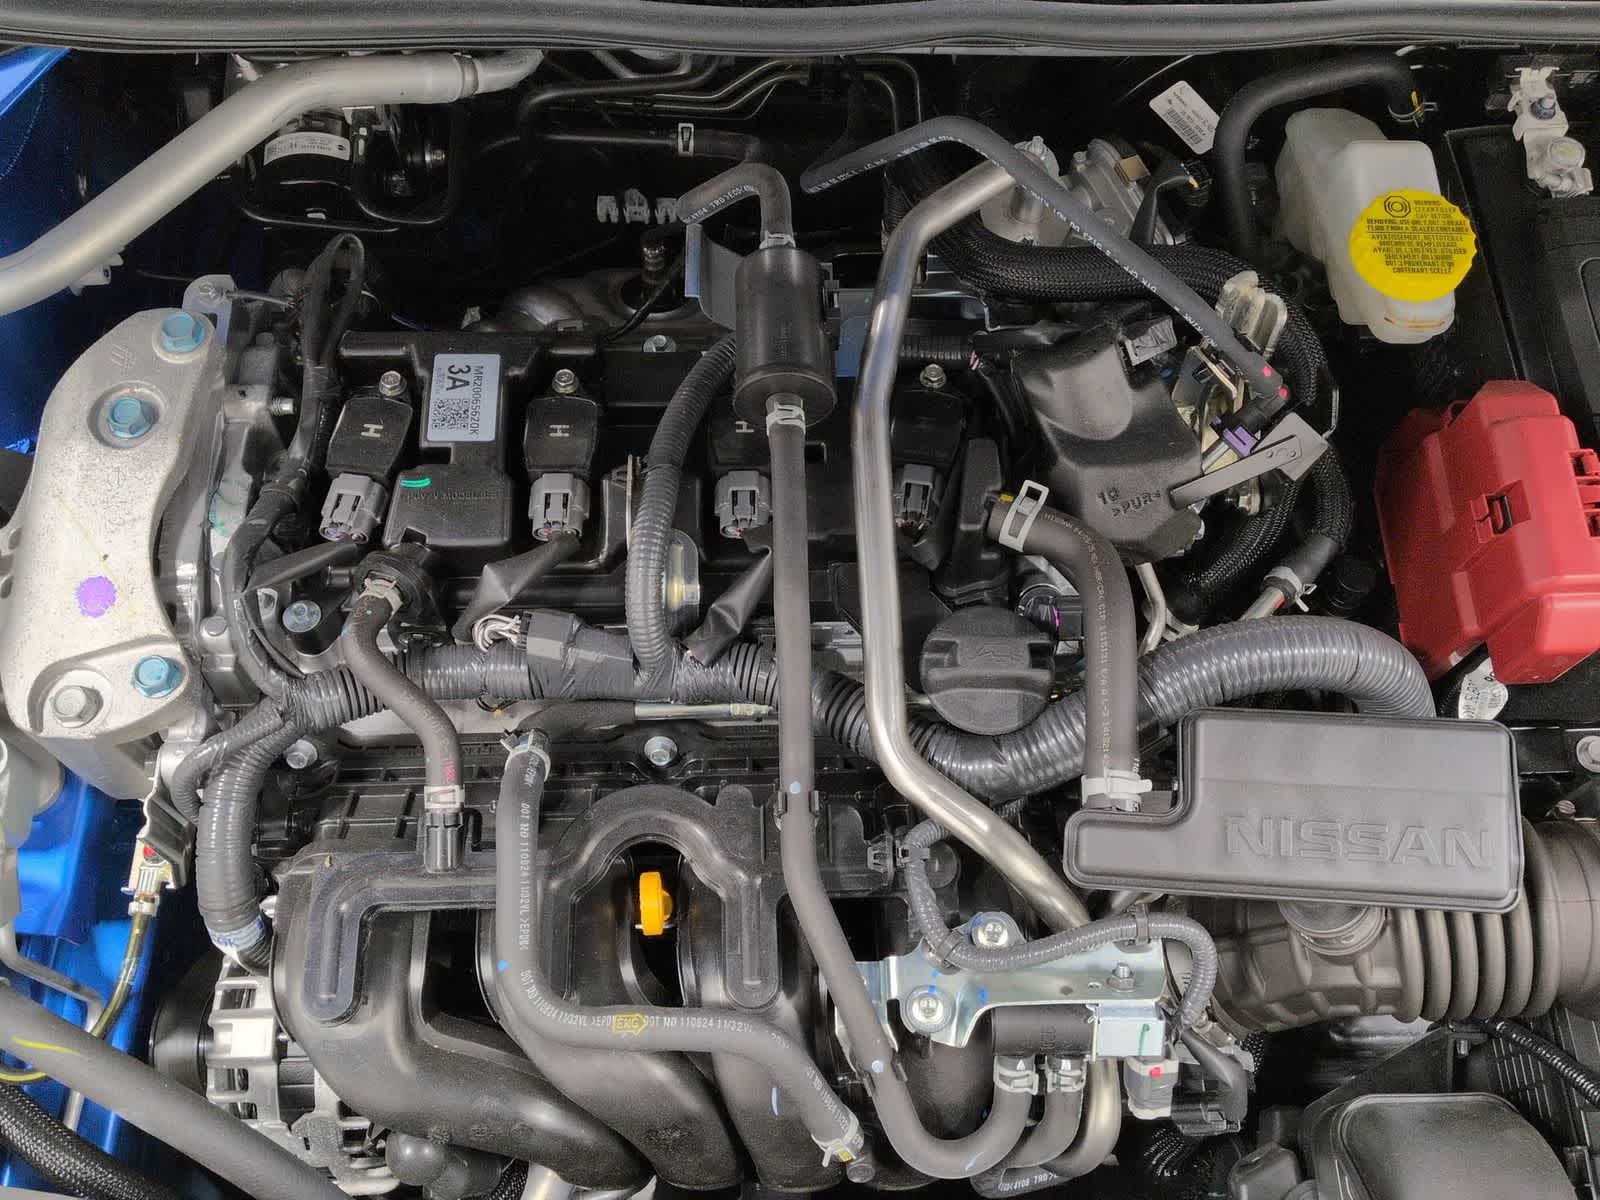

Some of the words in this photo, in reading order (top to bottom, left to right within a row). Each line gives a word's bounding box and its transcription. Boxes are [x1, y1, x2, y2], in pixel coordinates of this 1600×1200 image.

[446, 364, 471, 391] 3A
[361, 424, 384, 437] H
[549, 424, 570, 437] H
[1224, 815, 1491, 870] NISSAN
